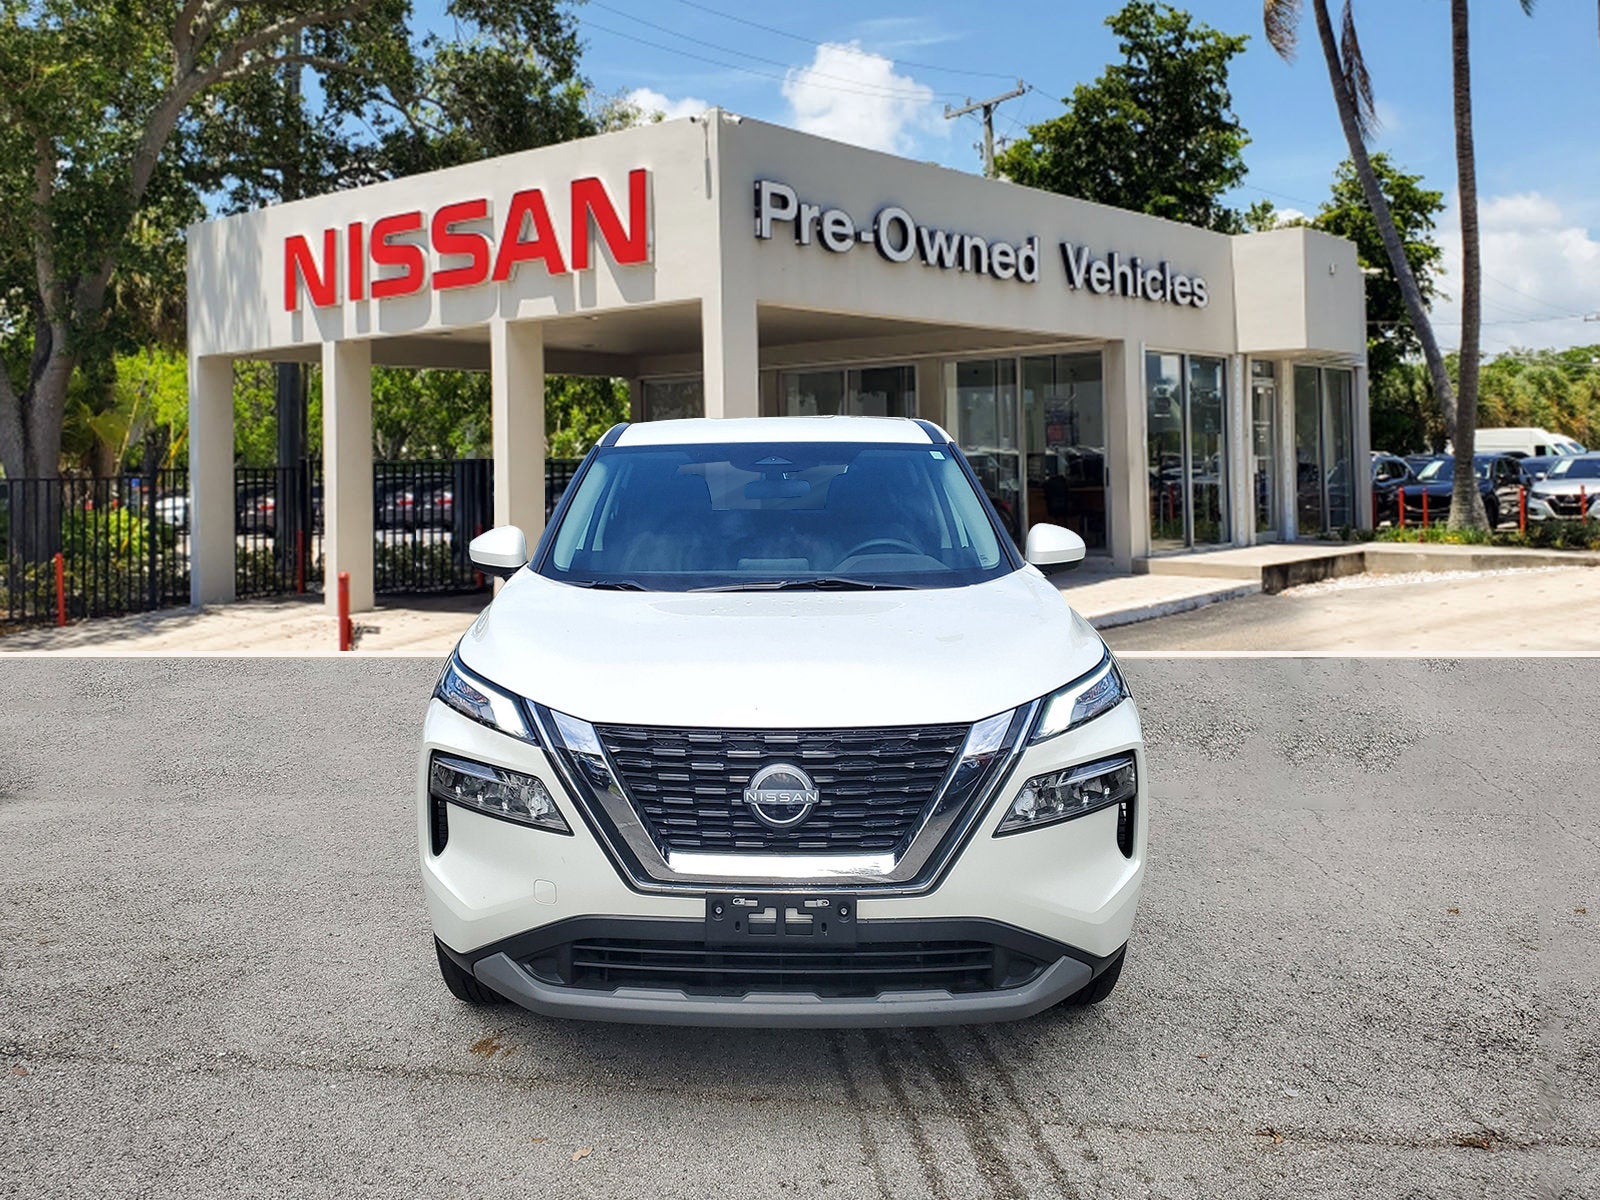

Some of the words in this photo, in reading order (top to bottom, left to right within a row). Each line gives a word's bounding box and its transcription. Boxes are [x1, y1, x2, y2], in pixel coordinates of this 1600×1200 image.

[285, 169, 647, 311] NISSAN
[755, 179, 1040, 283] Pre-Owned
[1061, 242, 1208, 308] Vehicles
[746, 792, 817, 802] NISSAN
